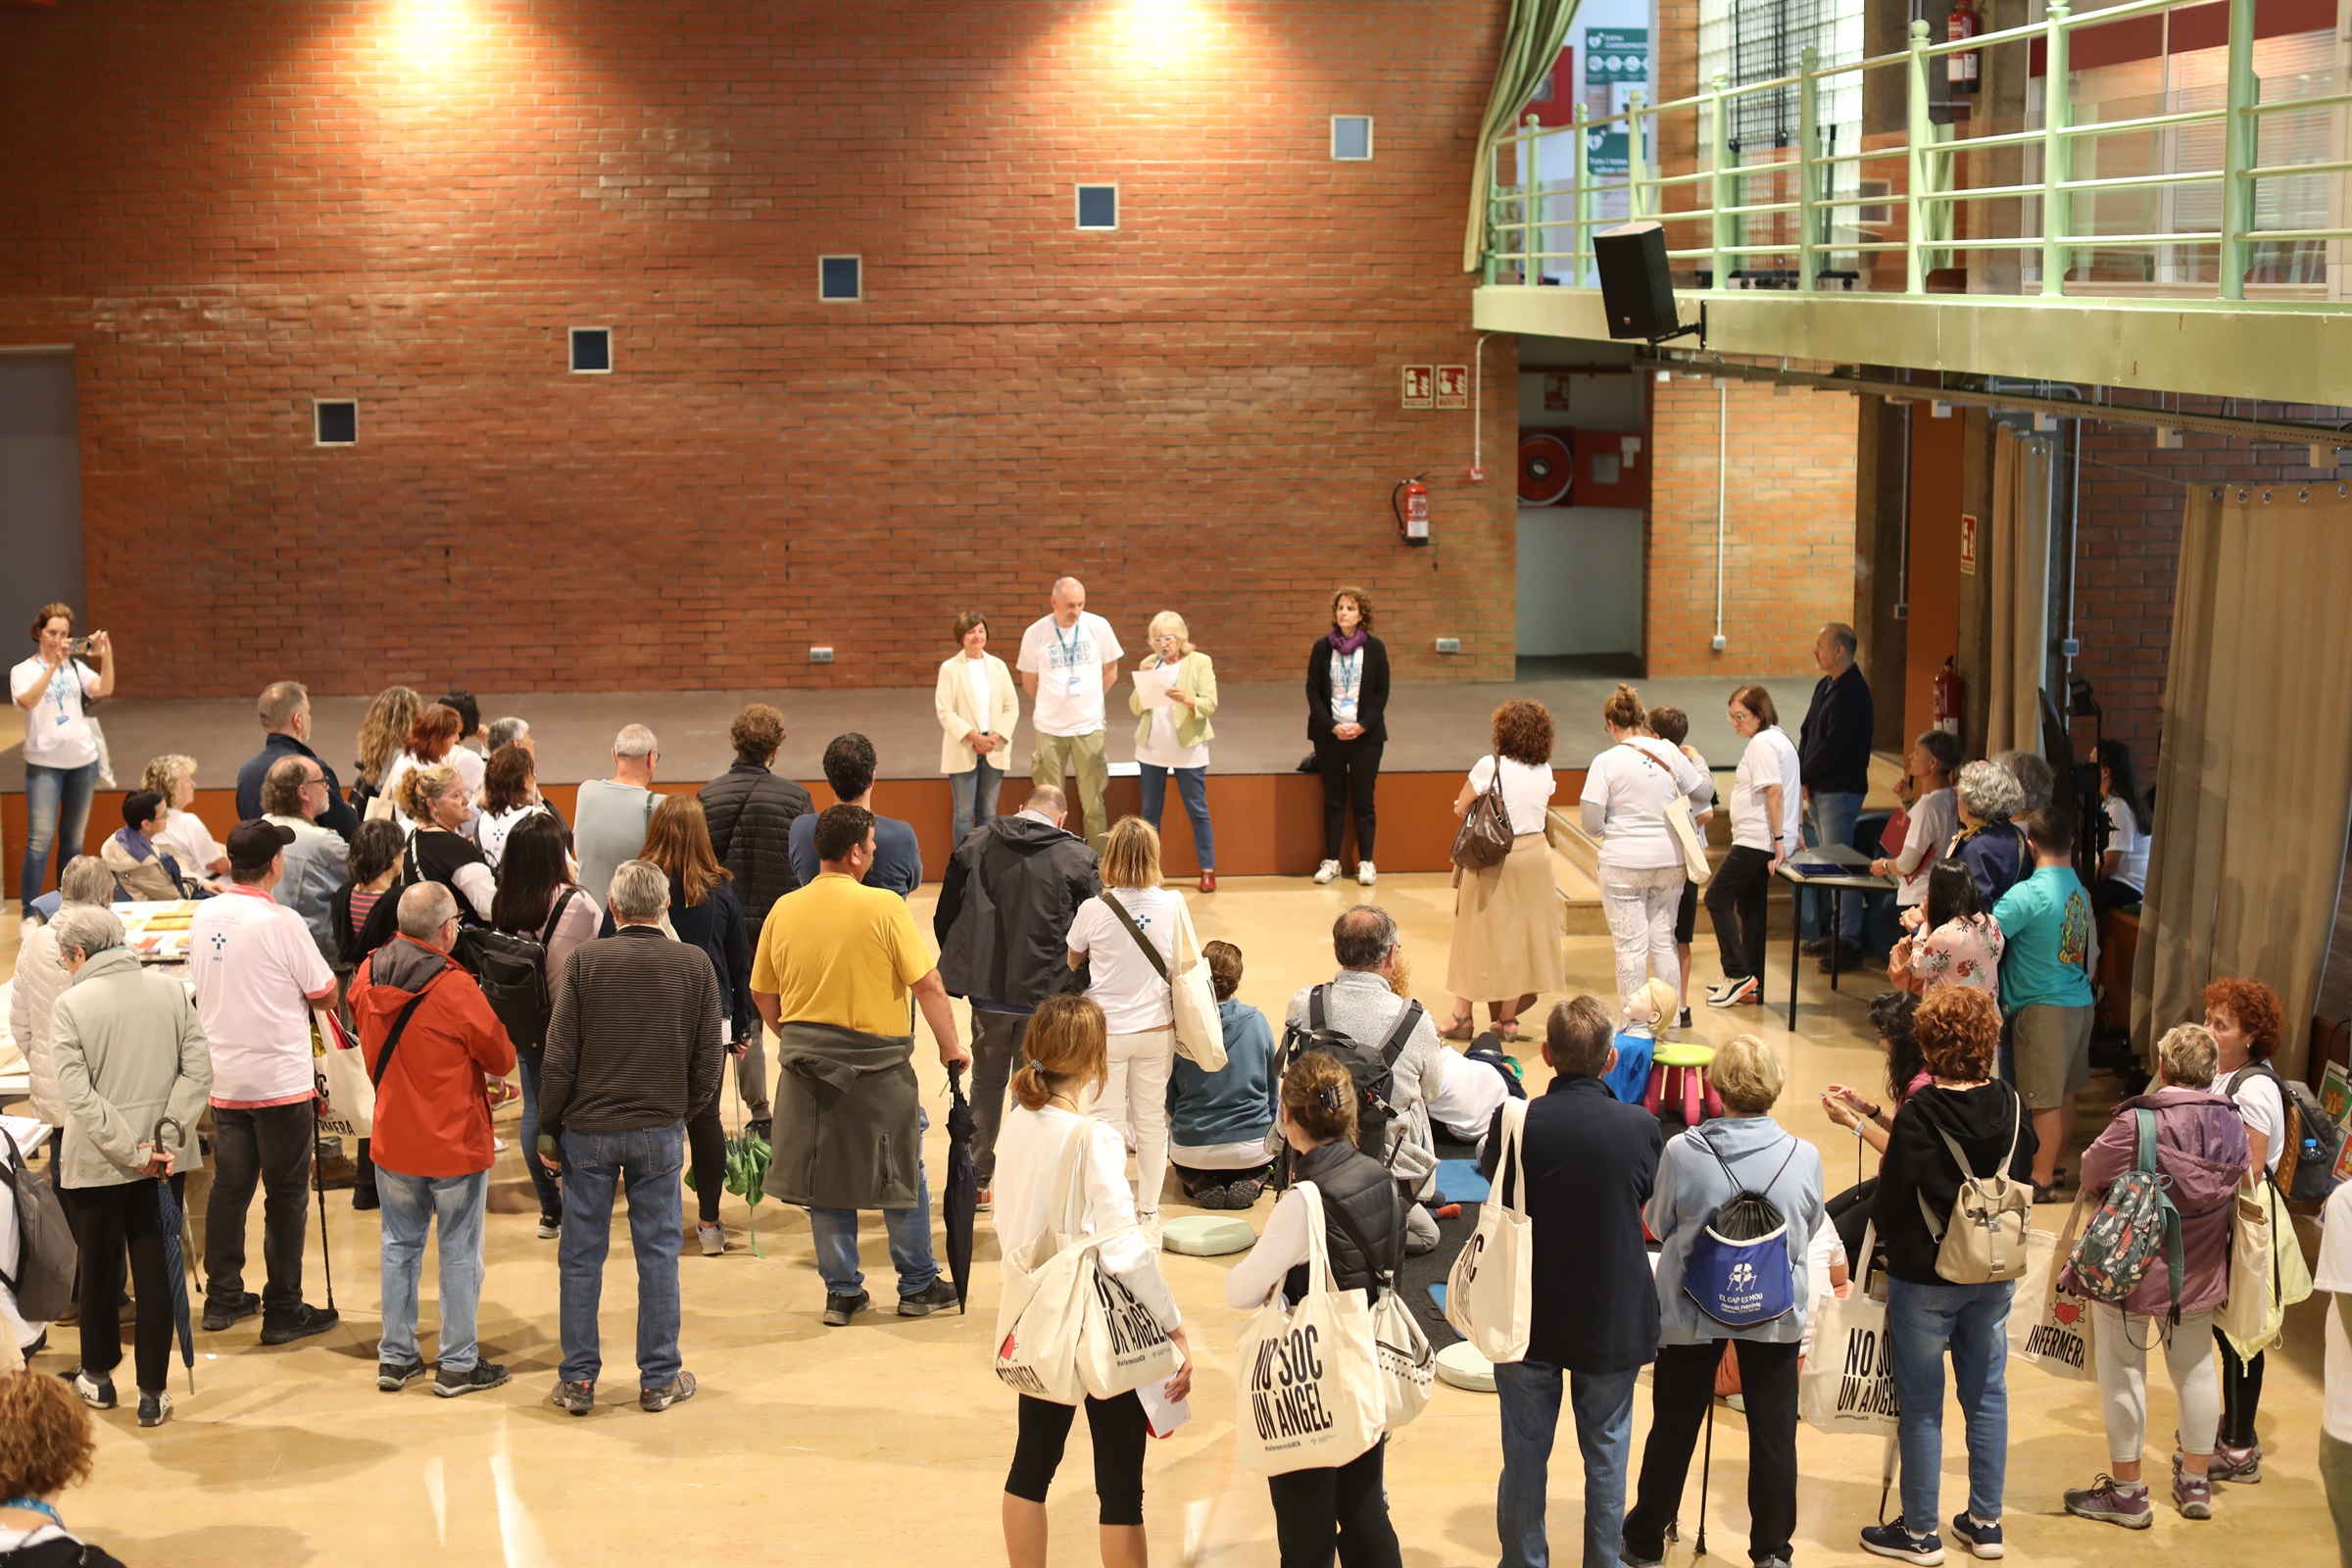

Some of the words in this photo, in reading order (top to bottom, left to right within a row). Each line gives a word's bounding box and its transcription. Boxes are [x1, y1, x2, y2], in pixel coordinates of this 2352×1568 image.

[1719, 1294, 1727, 1302] EL
[1749, 1292, 1763, 1301] MOU
[1251, 1338, 1278, 1392] NO
[1278, 1324, 1323, 1387] SOC
[1844, 1327, 1875, 1378] NO
[1877, 1328, 1893, 1378] SO
[1251, 1392, 1278, 1441] UN
[1273, 1382, 1333, 1438] ÀNGEL,
[1838, 1375, 1861, 1411] UN
